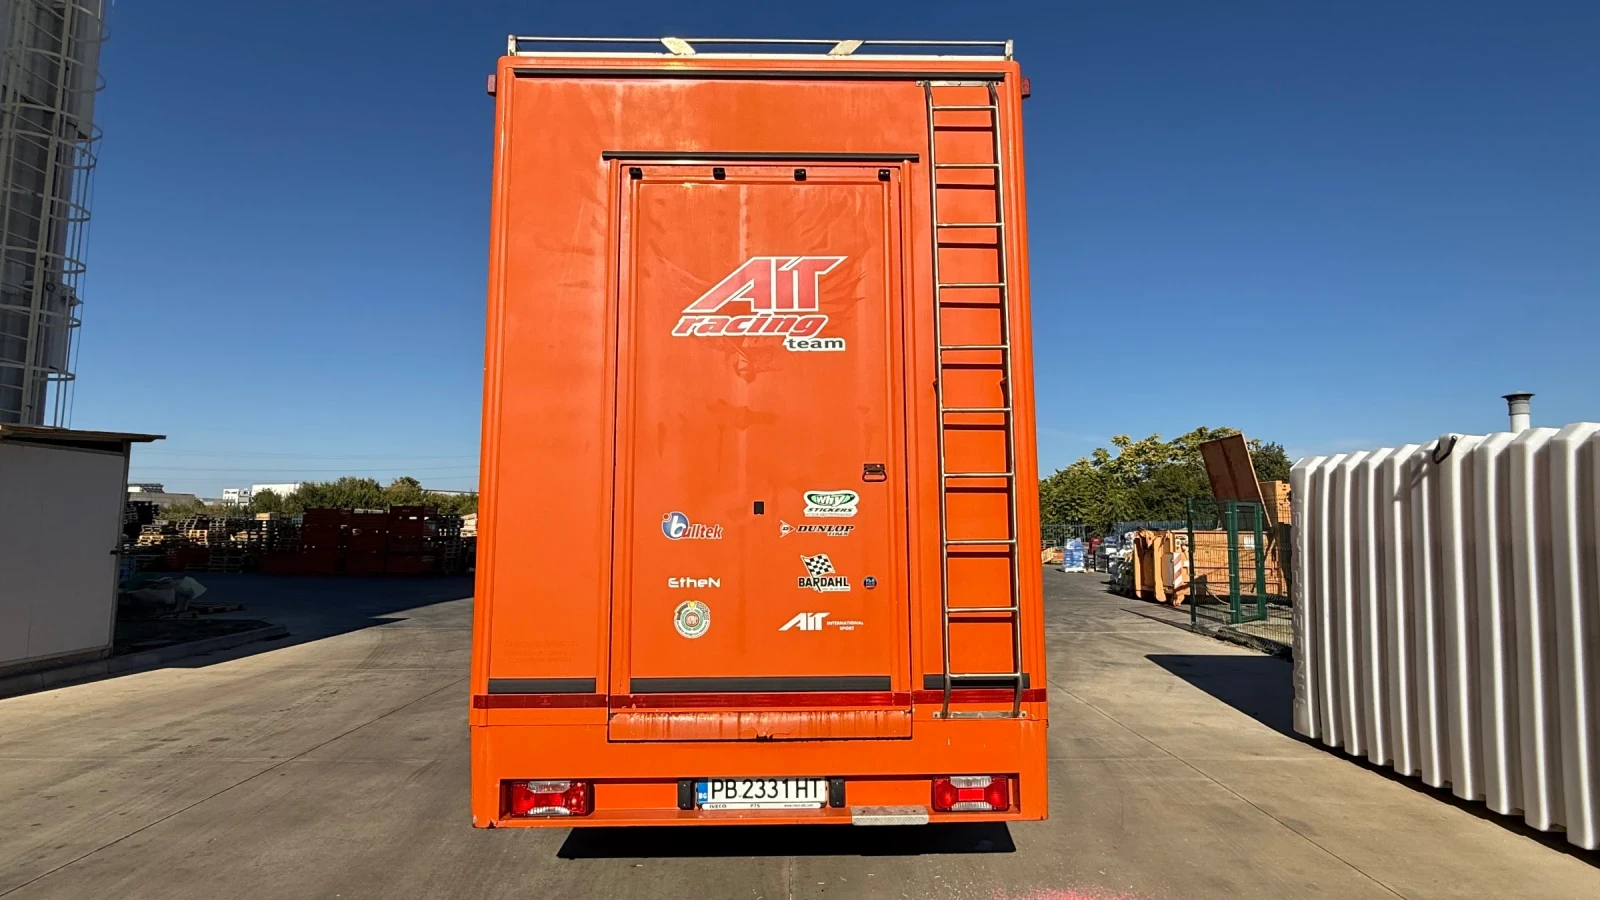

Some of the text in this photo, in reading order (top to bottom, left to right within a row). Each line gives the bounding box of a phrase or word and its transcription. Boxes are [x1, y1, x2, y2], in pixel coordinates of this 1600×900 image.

[672, 312, 828, 338] racing
[786, 338, 844, 350] team
[797, 525, 855, 533] DUNLOP
[798, 577, 850, 589] BARDAHL
[711, 778, 738, 799] PB
[742, 778, 789, 799] 2331
[795, 778, 822, 799] HT
